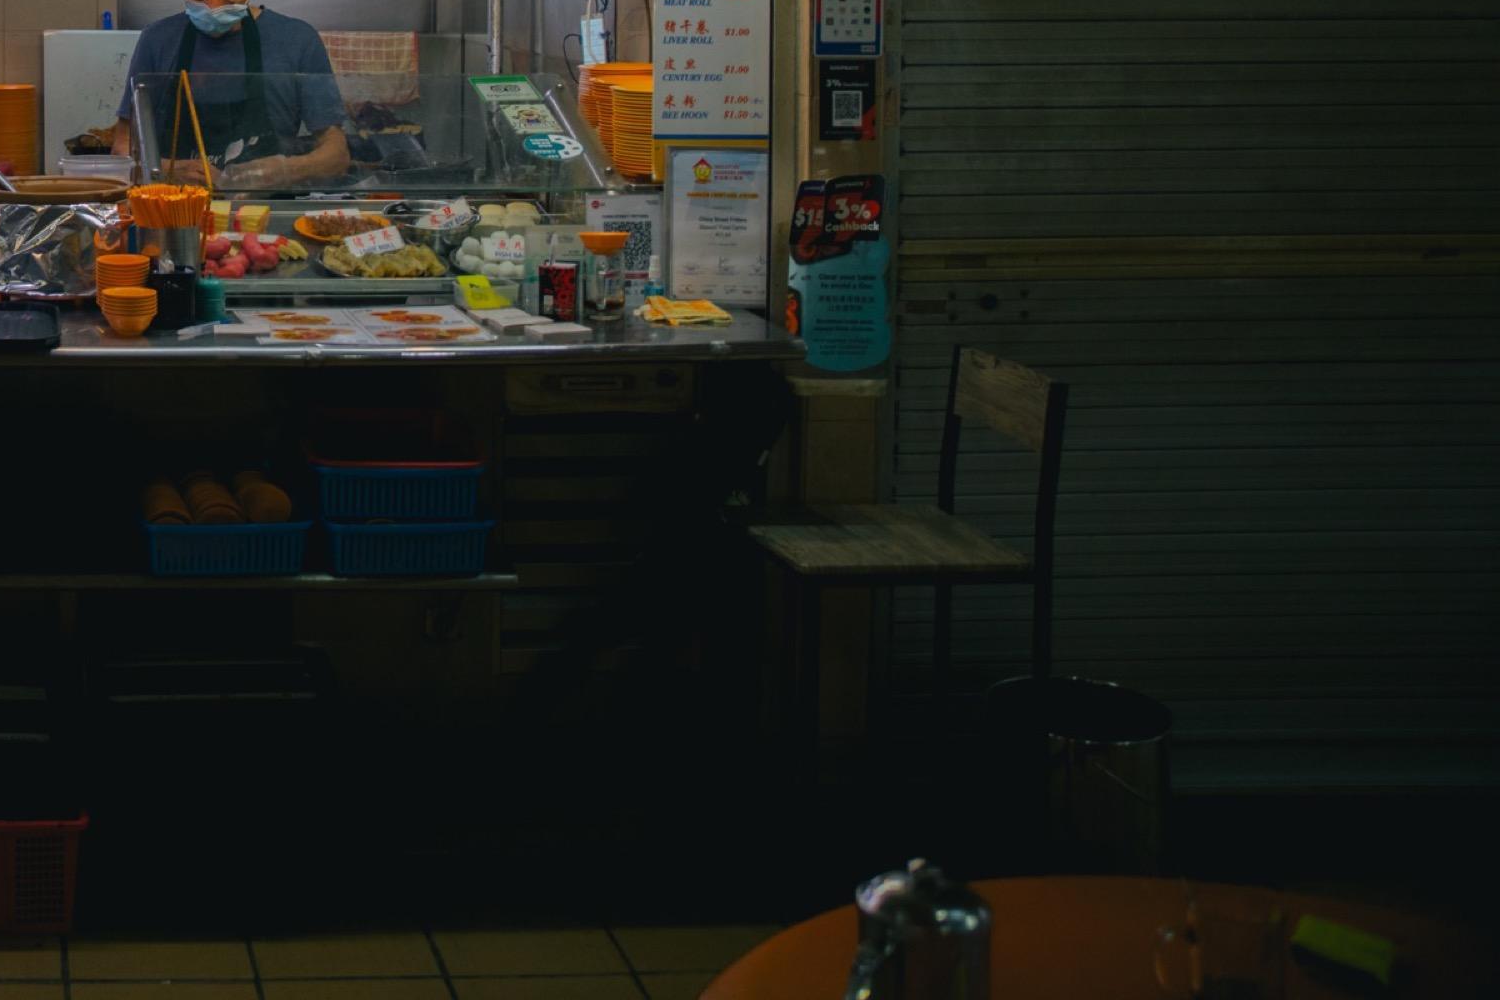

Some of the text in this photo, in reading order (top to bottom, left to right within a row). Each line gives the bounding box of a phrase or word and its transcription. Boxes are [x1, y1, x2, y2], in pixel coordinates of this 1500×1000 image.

[663, 36, 714, 44] LIVER ROLL
[662, 111, 708, 119] BEE HOON
[835, 198, 871, 220] 3%
[825, 220, 879, 232] Cashback
